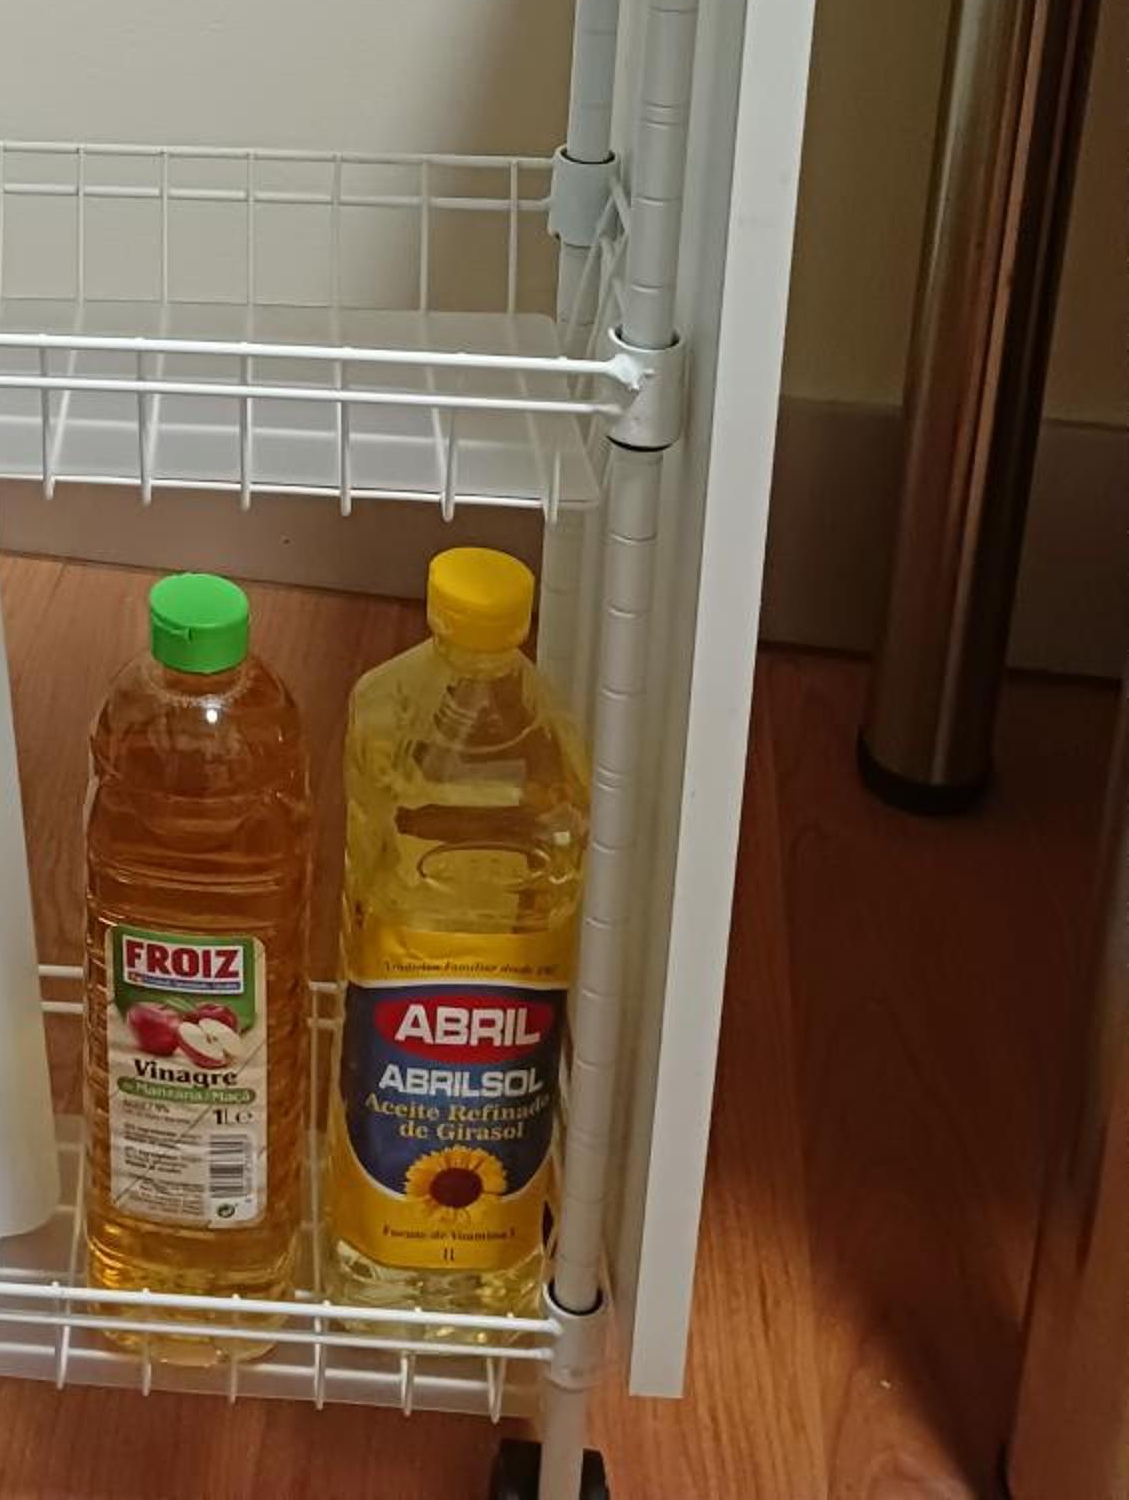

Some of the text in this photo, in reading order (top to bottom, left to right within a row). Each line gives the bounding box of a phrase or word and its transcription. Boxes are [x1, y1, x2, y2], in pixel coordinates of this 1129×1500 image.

[126, 939, 240, 978] FROIZ
[395, 1004, 540, 1046] ABRIL
[134, 1058, 238, 1088] Vinagre
[378, 1063, 544, 1098] ABRILSOL
[365, 1092, 440, 1122] Aceite
[399, 1120, 523, 1142] de Girasol
